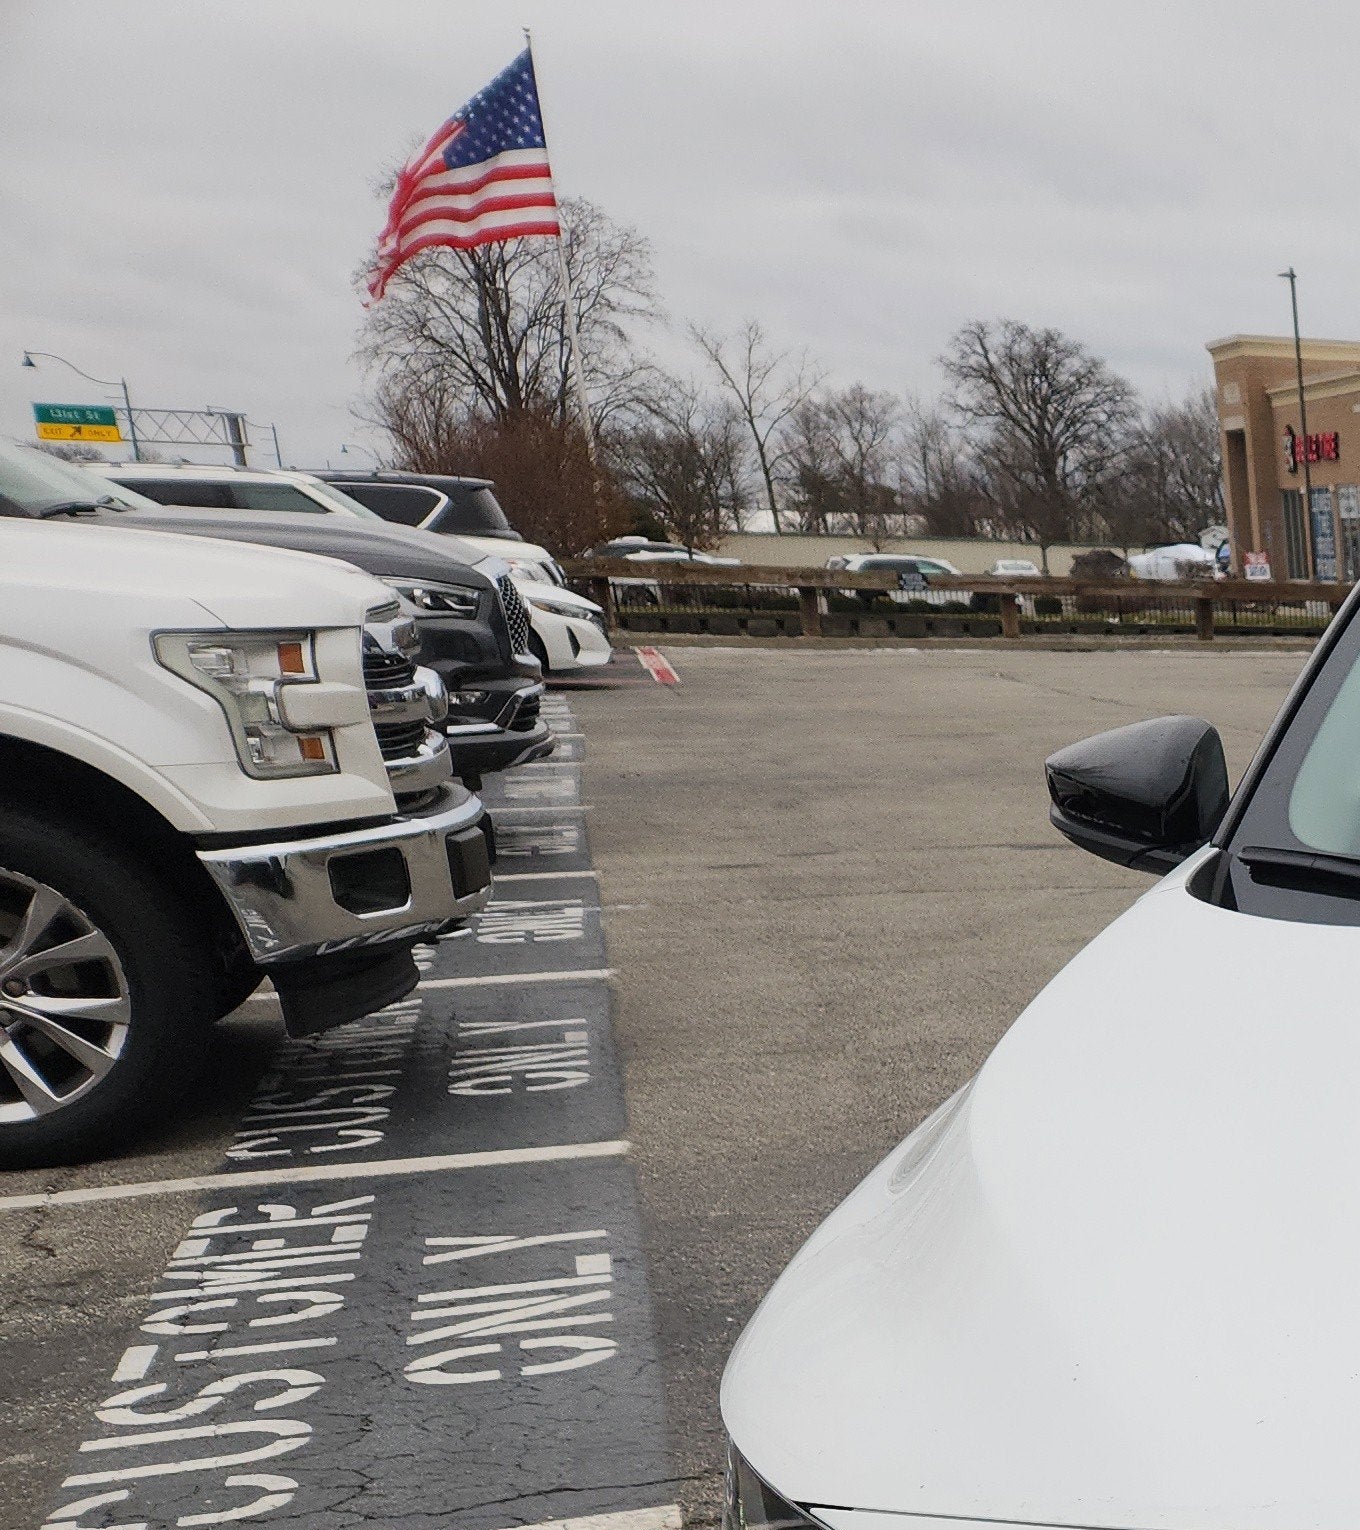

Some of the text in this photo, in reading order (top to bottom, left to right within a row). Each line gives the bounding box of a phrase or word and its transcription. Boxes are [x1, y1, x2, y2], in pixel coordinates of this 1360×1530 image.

[88, 429, 112, 437] ONLY
[448, 1017, 591, 1096] ONLY
[404, 1230, 618, 1385] ONLY
